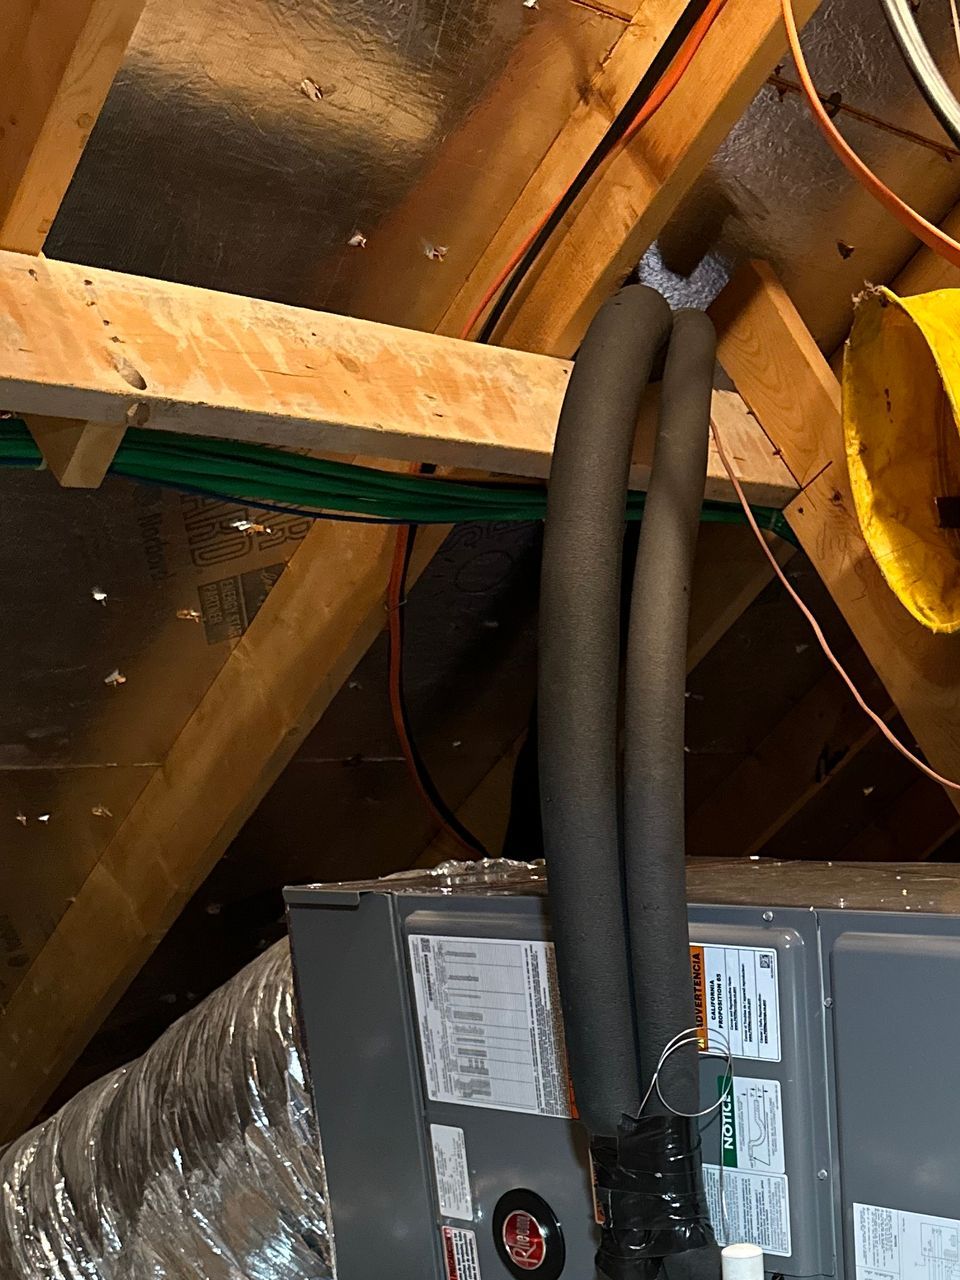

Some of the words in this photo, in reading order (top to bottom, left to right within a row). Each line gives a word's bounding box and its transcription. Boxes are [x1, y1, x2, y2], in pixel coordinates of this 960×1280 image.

[692, 953, 704, 1031] ADVERTENCIA
[716, 973, 722, 982] 65
[716, 983, 724, 1029] PROPOSITION
